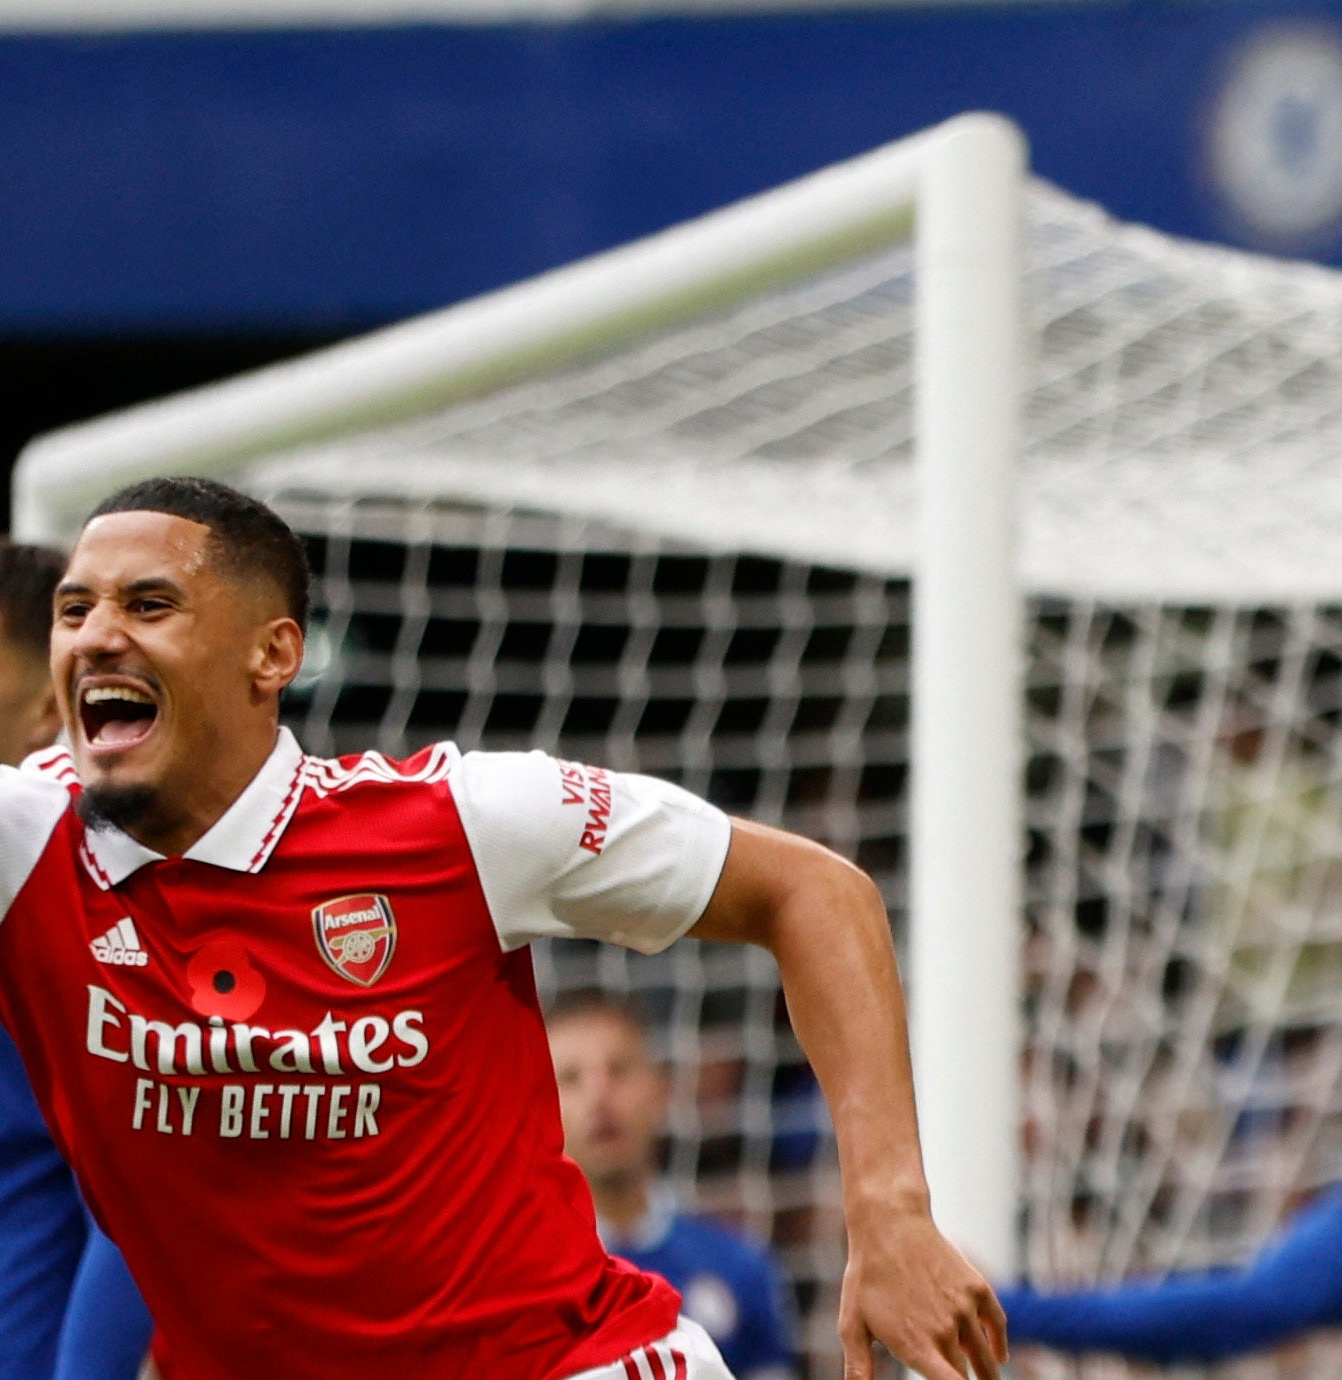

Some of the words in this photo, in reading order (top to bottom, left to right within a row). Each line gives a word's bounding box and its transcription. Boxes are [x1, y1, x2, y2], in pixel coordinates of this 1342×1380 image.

[324, 905, 381, 930] Arsenal
[86, 984, 429, 1075] Emirates
[132, 1078, 201, 1136] FLY
[219, 1084, 381, 1140] BETTER
